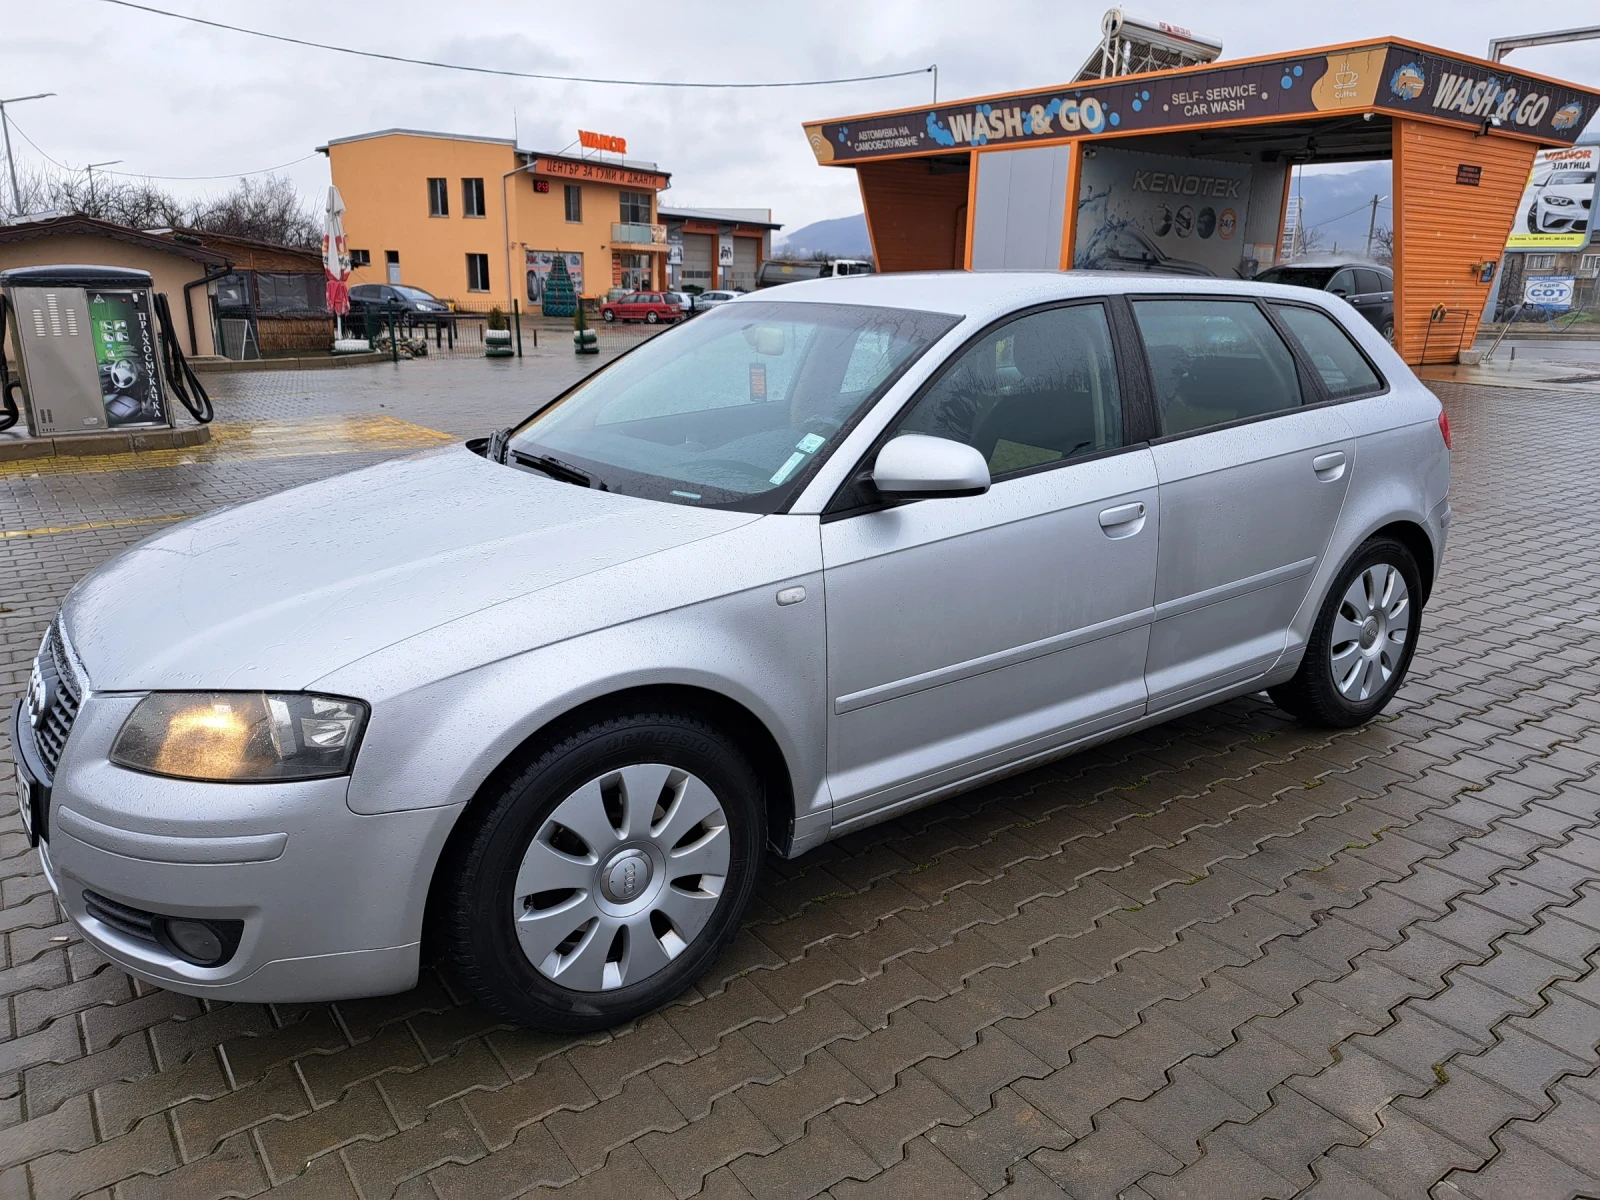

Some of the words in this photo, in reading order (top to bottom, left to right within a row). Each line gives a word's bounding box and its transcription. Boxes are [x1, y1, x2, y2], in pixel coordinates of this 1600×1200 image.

[1171, 90, 1203, 106] SELF-
[1205, 83, 1257, 100] SERVICE
[1432, 72, 1501, 118] WASH
[1498, 88, 1518, 122] &
[1515, 92, 1550, 127] GO
[1184, 104, 1209, 117] CAR
[1211, 99, 1246, 114] WASH
[948, 107, 1024, 143] WASH
[1030, 104, 1054, 135] &
[1058, 97, 1103, 132] GO
[578, 130, 627, 154] VIANOR
[854, 135, 919, 152] САМООБСЛУЖВАНЕ
[858, 127, 899, 141] АВТОМИВКА
[898, 125, 910, 136] НА
[1544, 149, 1592, 161] VIANOR
[1551, 161, 1591, 171] ЗЛАТИЦА
[546, 160, 579, 176] ЦЕНТЪР
[582, 165, 593, 177] ЗА
[596, 167, 617, 181] ГУМИ
[620, 171, 625, 181] И
[627, 172, 658, 186] ДЖАНТИ
[1132, 170, 1241, 199] KENOTEK
[1220, 219, 1236, 229] 24/7
[138, 312, 162, 417] ПРАХОСМУКАЧКА
